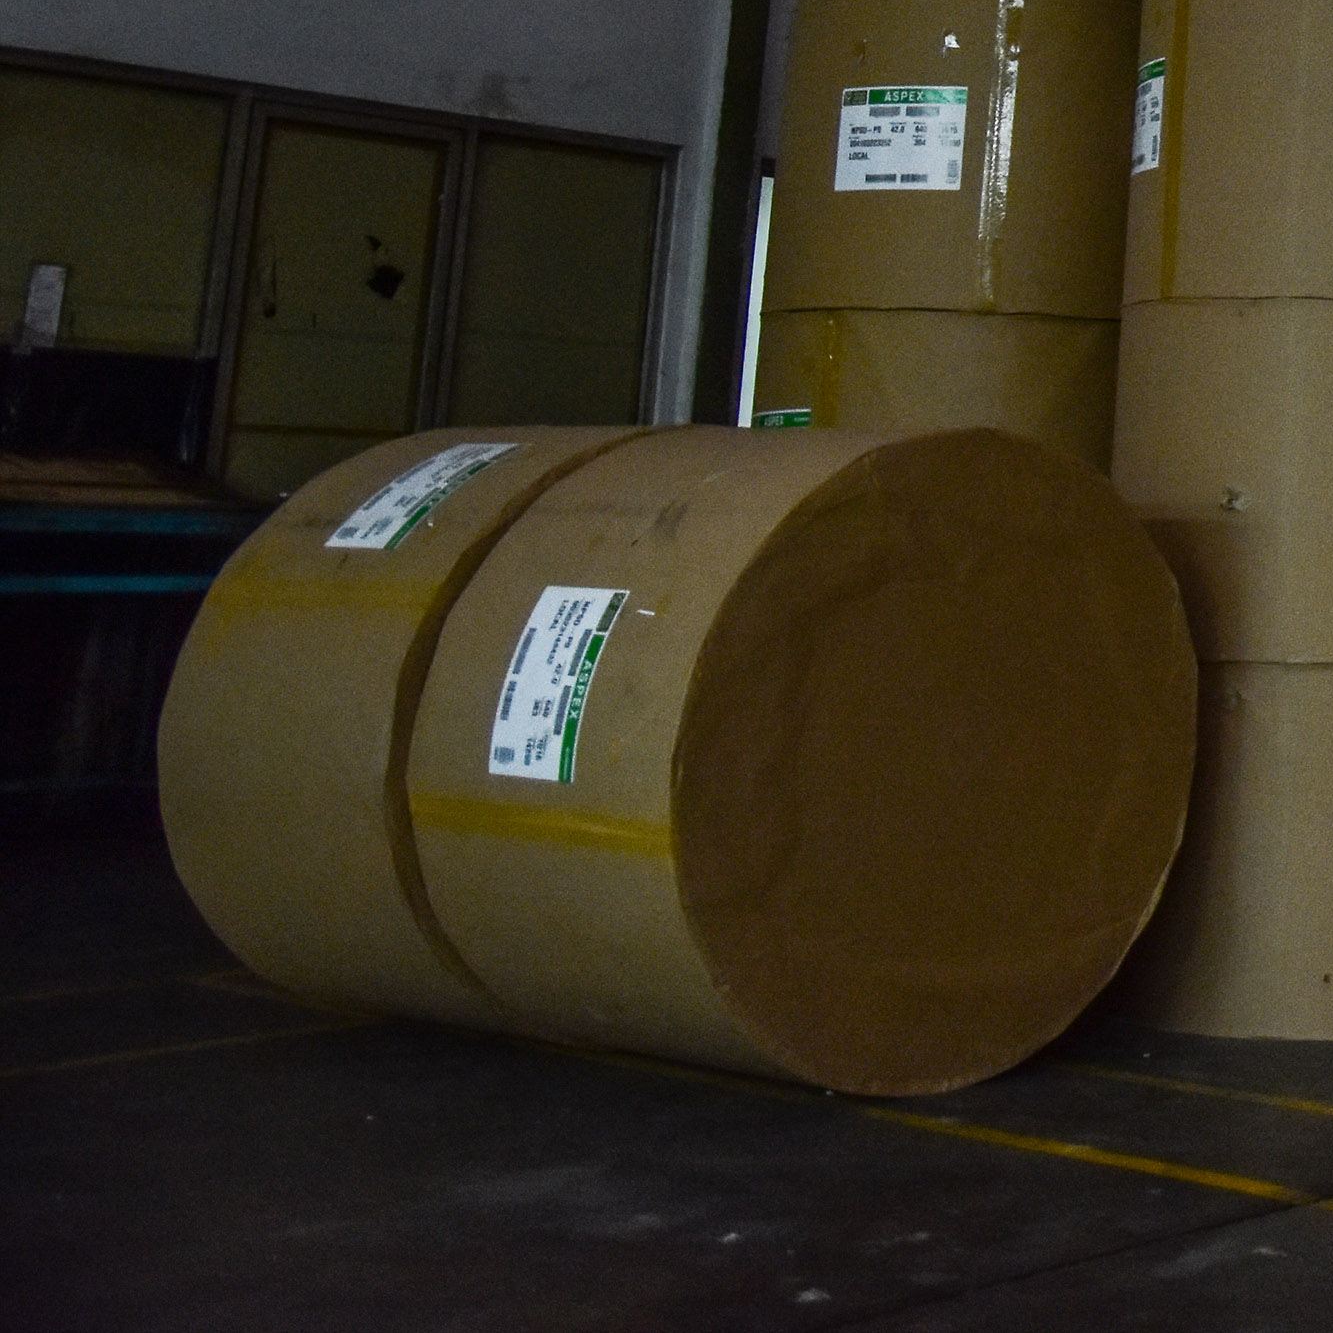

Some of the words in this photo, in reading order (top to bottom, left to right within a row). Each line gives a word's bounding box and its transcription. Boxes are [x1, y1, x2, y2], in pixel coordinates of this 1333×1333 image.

[884, 91, 924, 102] ASPEX
[849, 152, 870, 161] LOCAL
[568, 658, 594, 718] ASPEX
